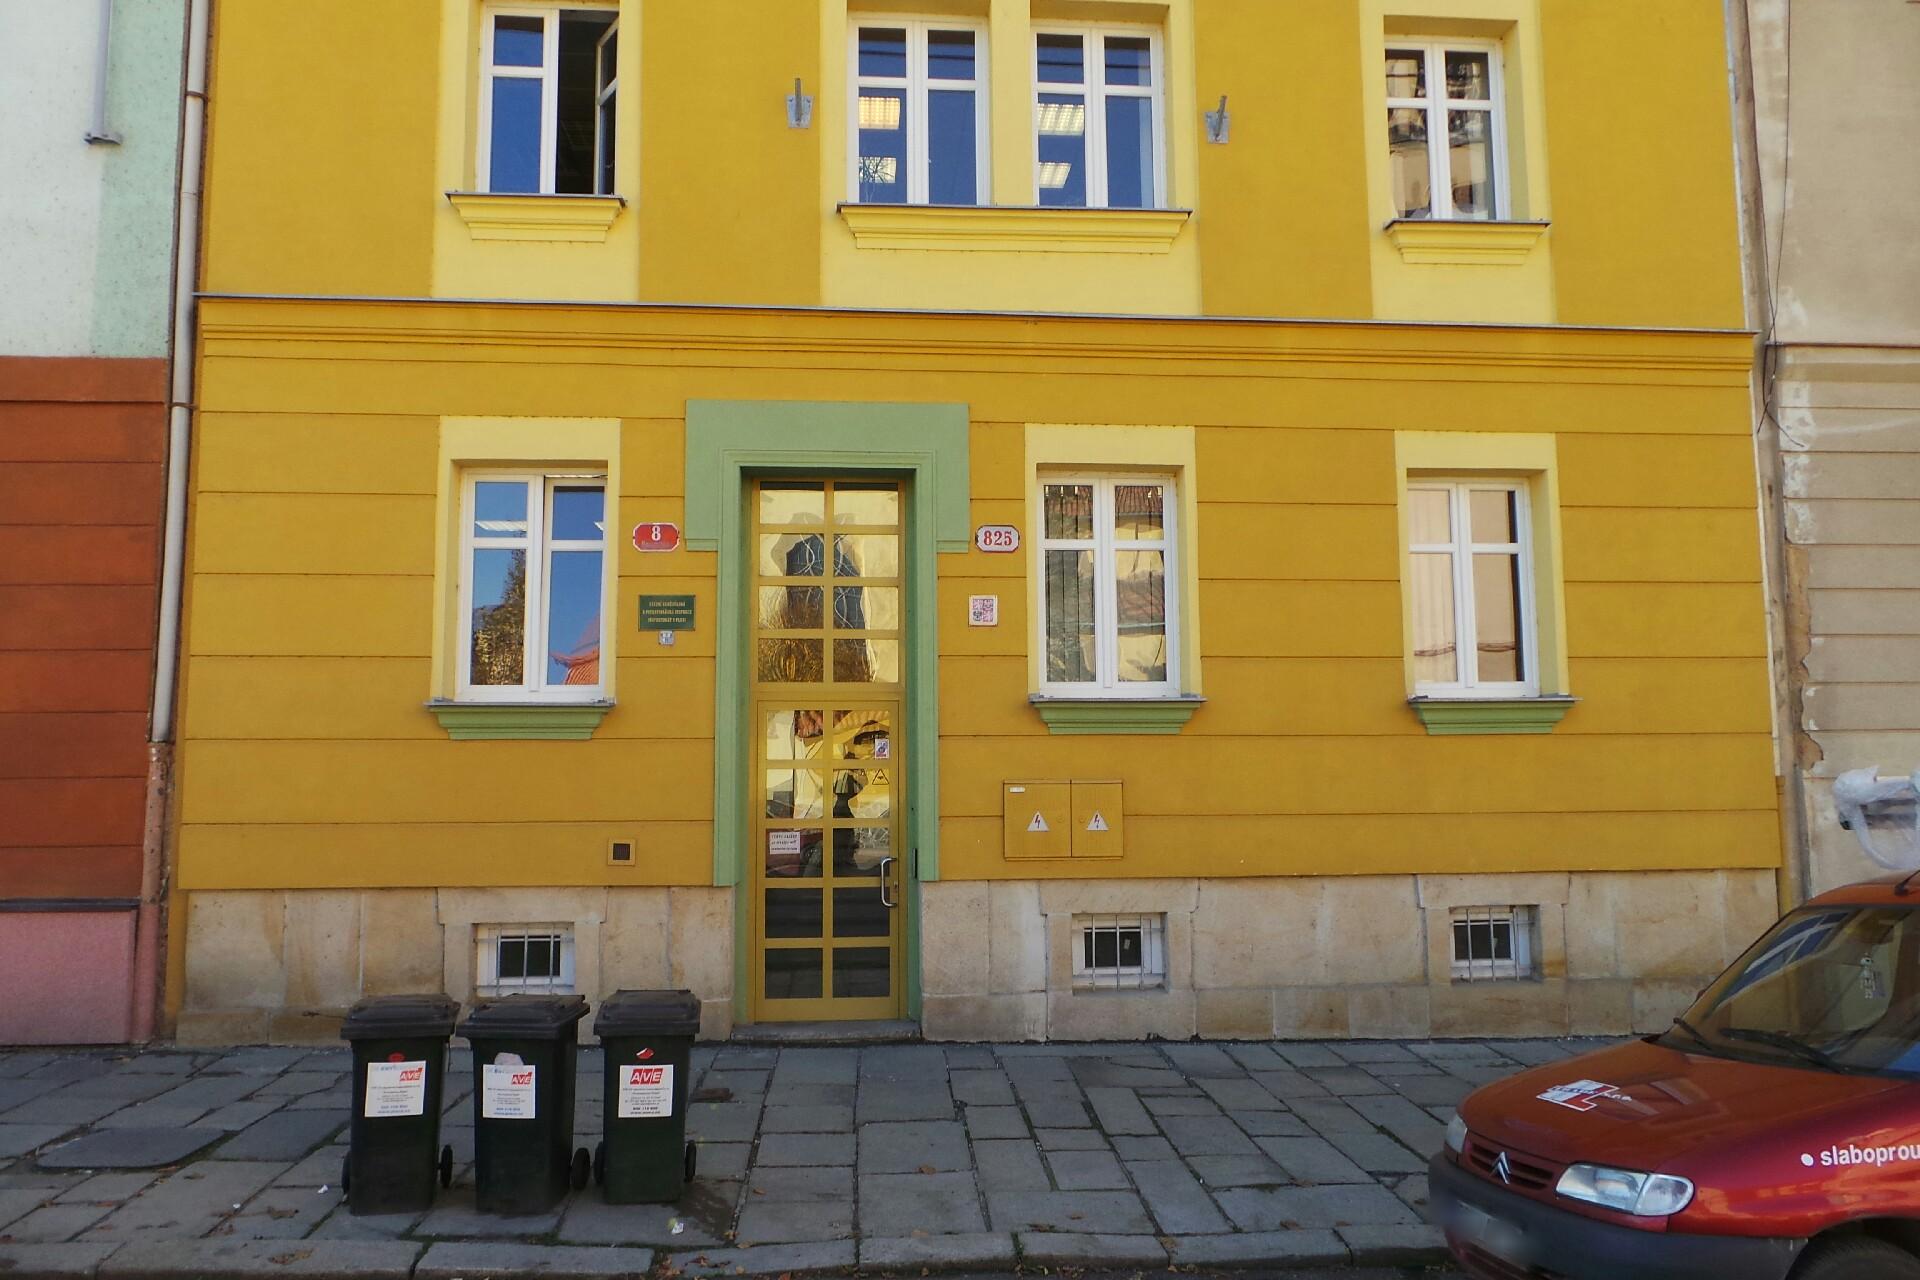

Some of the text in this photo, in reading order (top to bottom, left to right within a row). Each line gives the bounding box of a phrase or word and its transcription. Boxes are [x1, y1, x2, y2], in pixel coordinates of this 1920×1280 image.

[651, 525, 661, 541] 8
[983, 530, 1013, 546] 825
[400, 1070, 422, 1081] AVE
[512, 1073, 532, 1084] AVE
[631, 1070, 662, 1083] AVE
